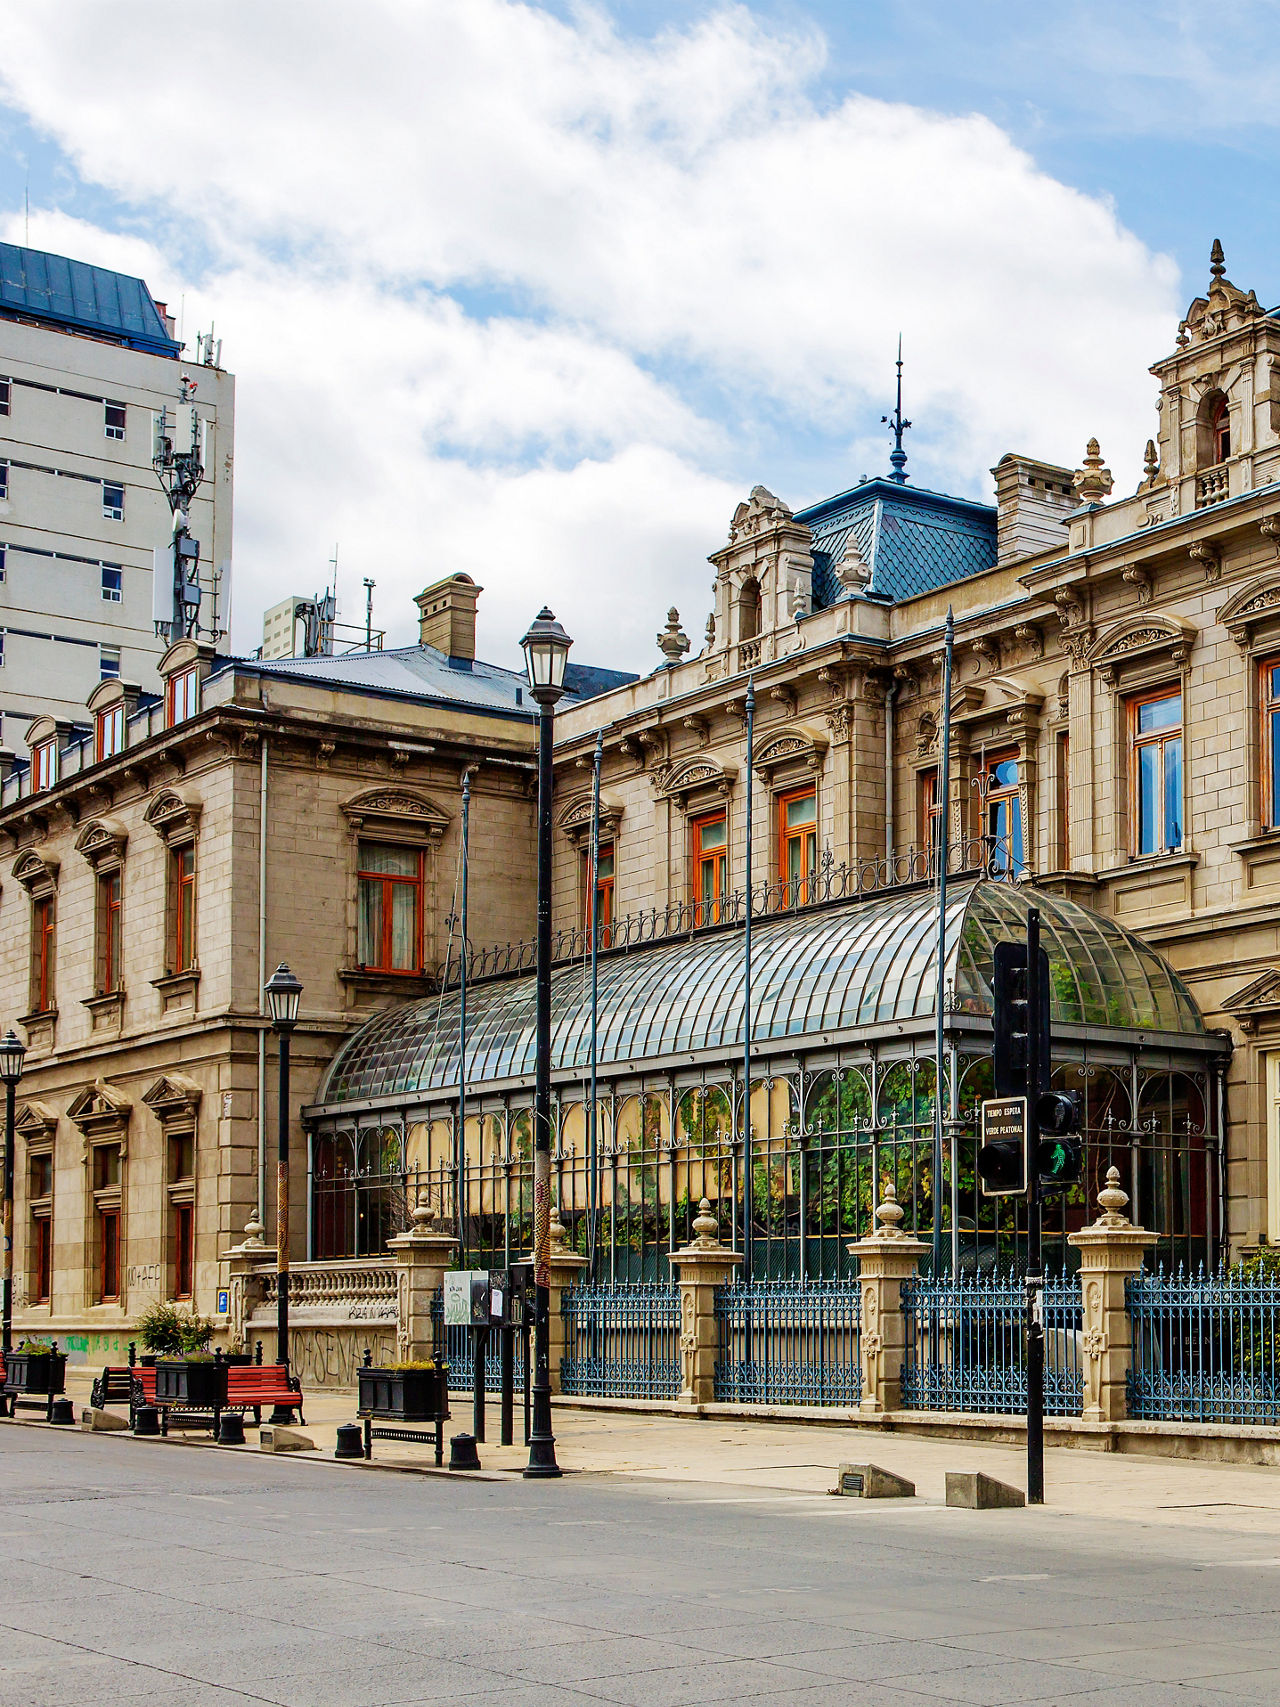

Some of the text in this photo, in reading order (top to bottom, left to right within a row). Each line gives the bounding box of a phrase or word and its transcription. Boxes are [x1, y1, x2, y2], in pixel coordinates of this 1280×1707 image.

[987, 1106, 1021, 1118] TIEMPO ESPERA
[986, 1125, 1023, 1135] VERDE PEATONAL
